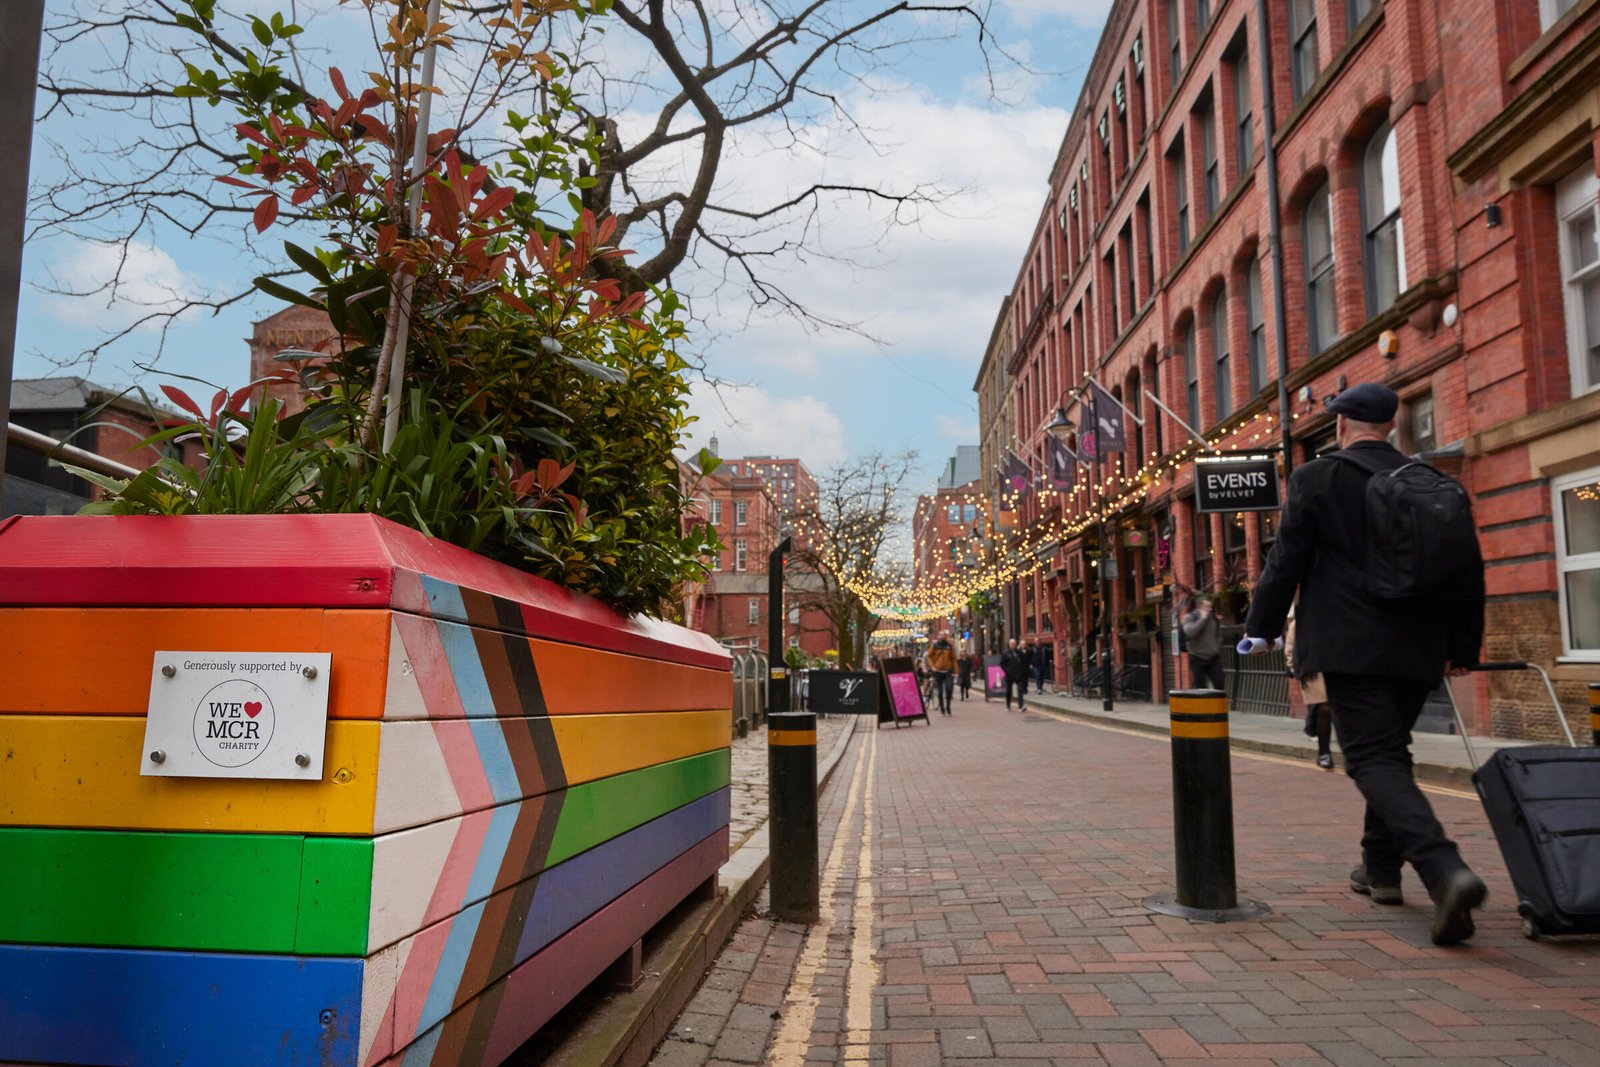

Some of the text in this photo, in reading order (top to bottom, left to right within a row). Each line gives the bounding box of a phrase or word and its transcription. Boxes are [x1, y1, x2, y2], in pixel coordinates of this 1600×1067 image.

[1059, 39, 1141, 230] VELVET
[1207, 472, 1267, 489] EVENTS
[1209, 490, 1255, 500] by VELVET
[184, 660, 302, 674] Generously supported by
[209, 702, 242, 718] WE
[206, 720, 260, 739] MCR
[219, 742, 260, 750] CHARITY
